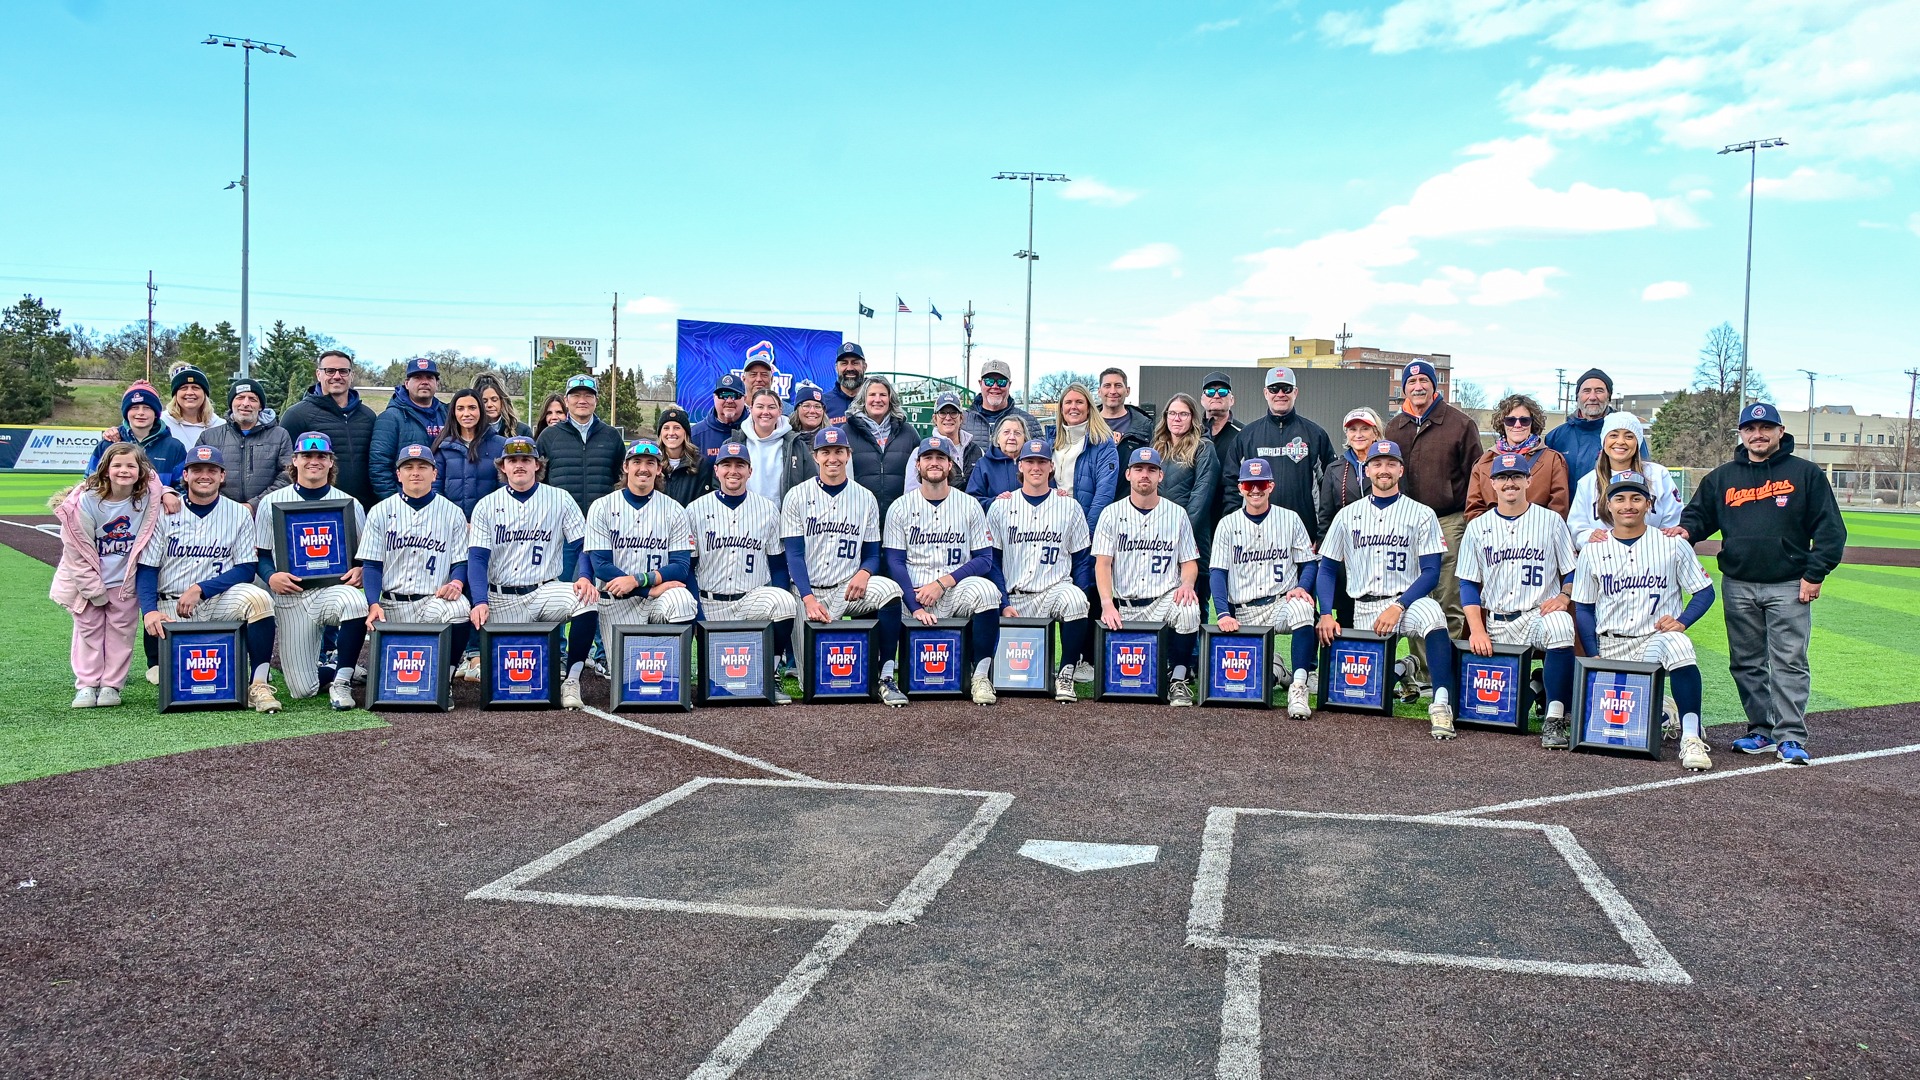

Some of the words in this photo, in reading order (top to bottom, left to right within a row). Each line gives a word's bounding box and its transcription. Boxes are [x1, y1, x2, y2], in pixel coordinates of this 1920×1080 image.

[56, 437, 99, 446] NACCO
[1256, 447, 1281, 457] WORLD
[1281, 446, 1309, 456] SERIES
[1725, 479, 1795, 507] Marauders
[494, 522, 552, 546] Marauders
[805, 516, 860, 537] Marauders
[909, 525, 966, 545] Marauders
[1007, 525, 1062, 545] Marauders
[166, 536, 232, 558] Marauders
[299, 534, 333, 547] MARY
[385, 529, 447, 553] Marauders
[609, 529, 668, 550] Marauders
[706, 530, 762, 552] Marauders
[1117, 532, 1174, 552] Marauders
[1351, 528, 1410, 549] Marauders
[531, 545, 543, 566] 6
[837, 539, 857, 560] 20
[946, 548, 962, 567] 19
[1040, 546, 1060, 565] 30
[1233, 542, 1290, 565] Marauders
[1483, 540, 1545, 568] Marauders
[212, 561, 223, 576] 3
[426, 555, 436, 576] 4
[646, 554, 662, 573] 13
[745, 554, 754, 574] 9
[1151, 555, 1172, 574] 27
[1386, 551, 1407, 572] 33
[1273, 563, 1284, 583] 5
[1521, 564, 1544, 587] 36
[1600, 567, 1668, 597] Marauders
[1650, 593, 1661, 616] 7
[186, 657, 222, 670] MARY
[504, 657, 537, 670] MARY
[720, 654, 751, 666] MARY
[826, 653, 857, 665] MARY
[920, 650, 950, 663] MARY
[1005, 648, 1035, 660] MARY
[1116, 653, 1146, 666] MARY
[1221, 657, 1252, 671] MARY
[392, 658, 426, 672] MARY
[636, 658, 668, 671] MARY
[1341, 661, 1372, 676] MARY
[1473, 676, 1506, 692] MARY
[1599, 697, 1636, 713] MARY
